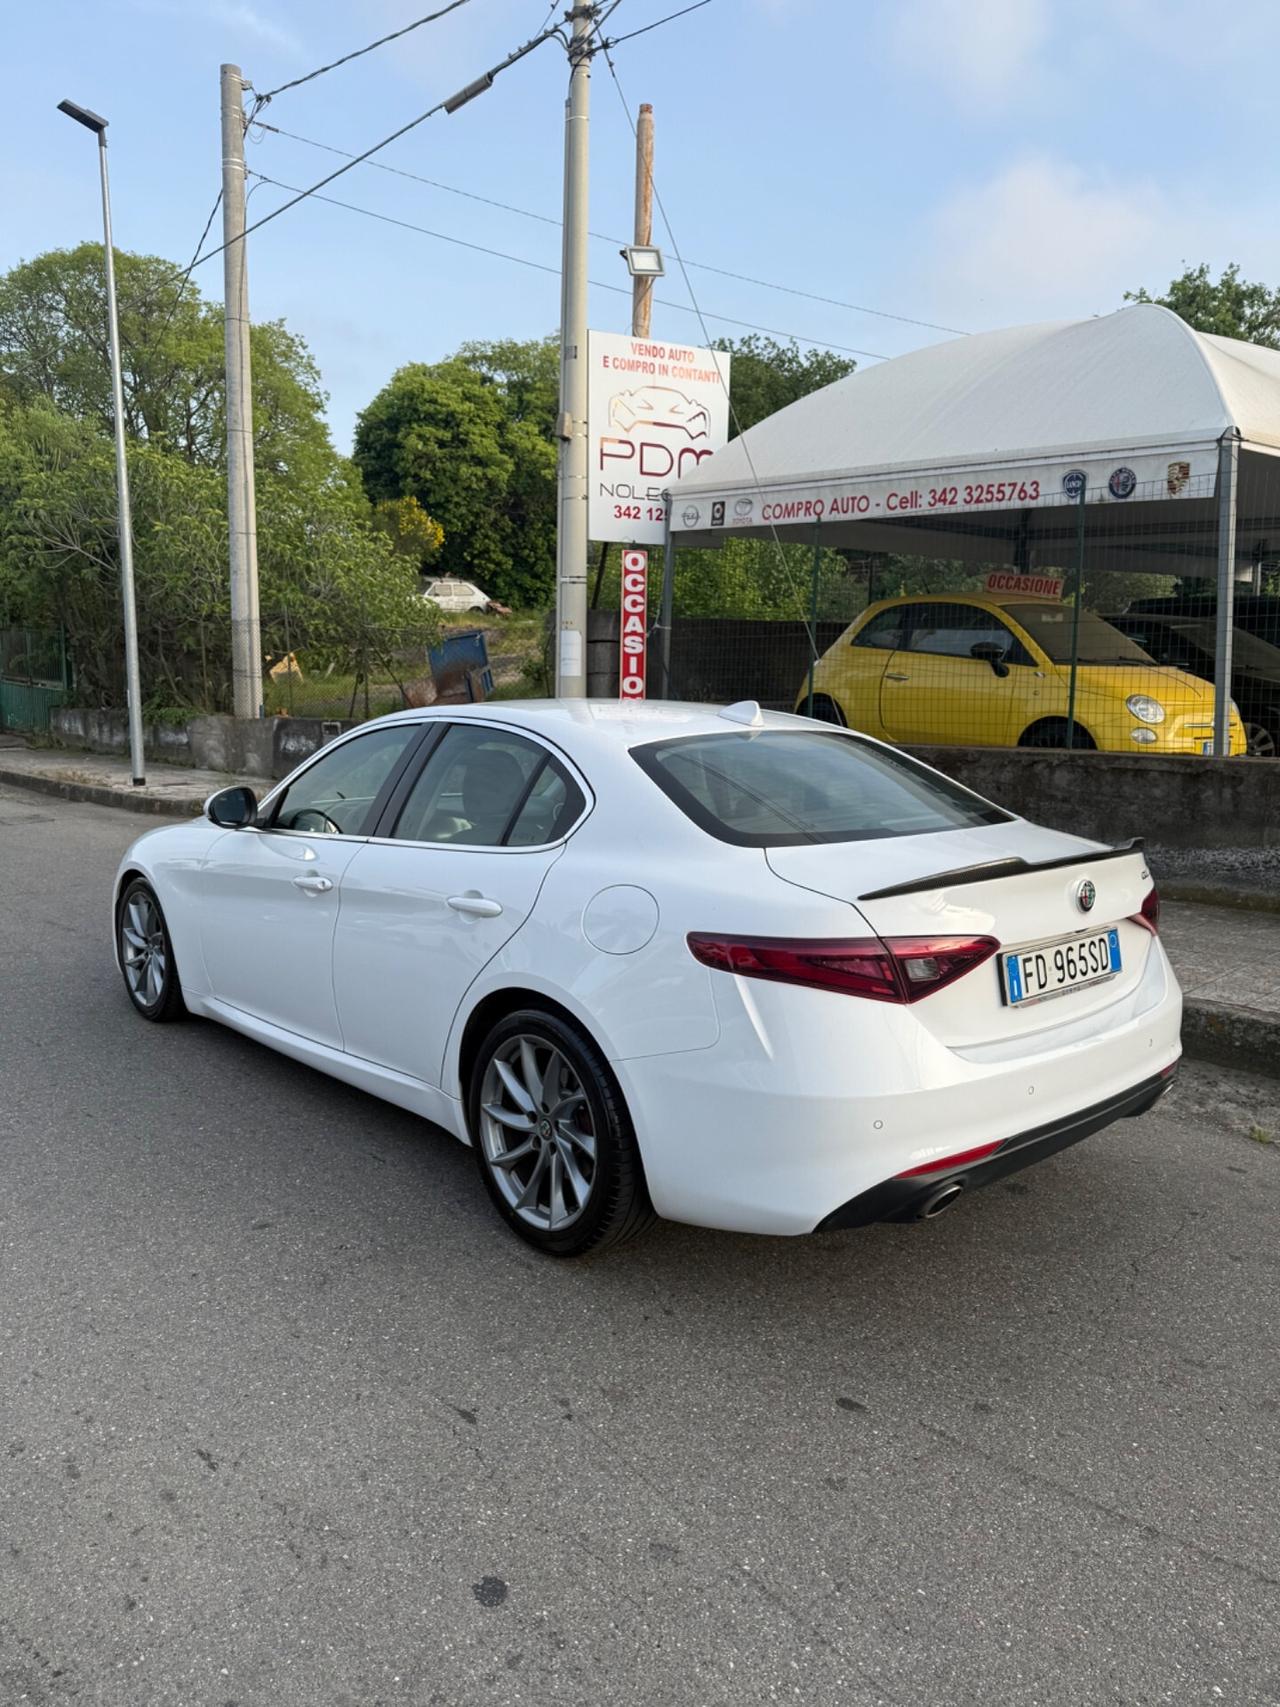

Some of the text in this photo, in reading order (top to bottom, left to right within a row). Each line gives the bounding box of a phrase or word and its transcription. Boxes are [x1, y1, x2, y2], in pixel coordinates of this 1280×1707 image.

[631, 342, 695, 363] VENDO AUTO
[602, 355, 720, 384] E COMPRO IN CONTANTI
[614, 505, 642, 520] 342
[761, 499, 825, 521] COMPRO
[829, 495, 870, 516] AUTO
[886, 490, 923, 511] Cell:
[928, 486, 958, 508] 342
[963, 480, 1040, 505] 3255763
[987, 574, 1062, 595] OCCASIONE
[623, 552, 645, 699] OCCASIO
[1021, 937, 1109, 993] FD 965SD
